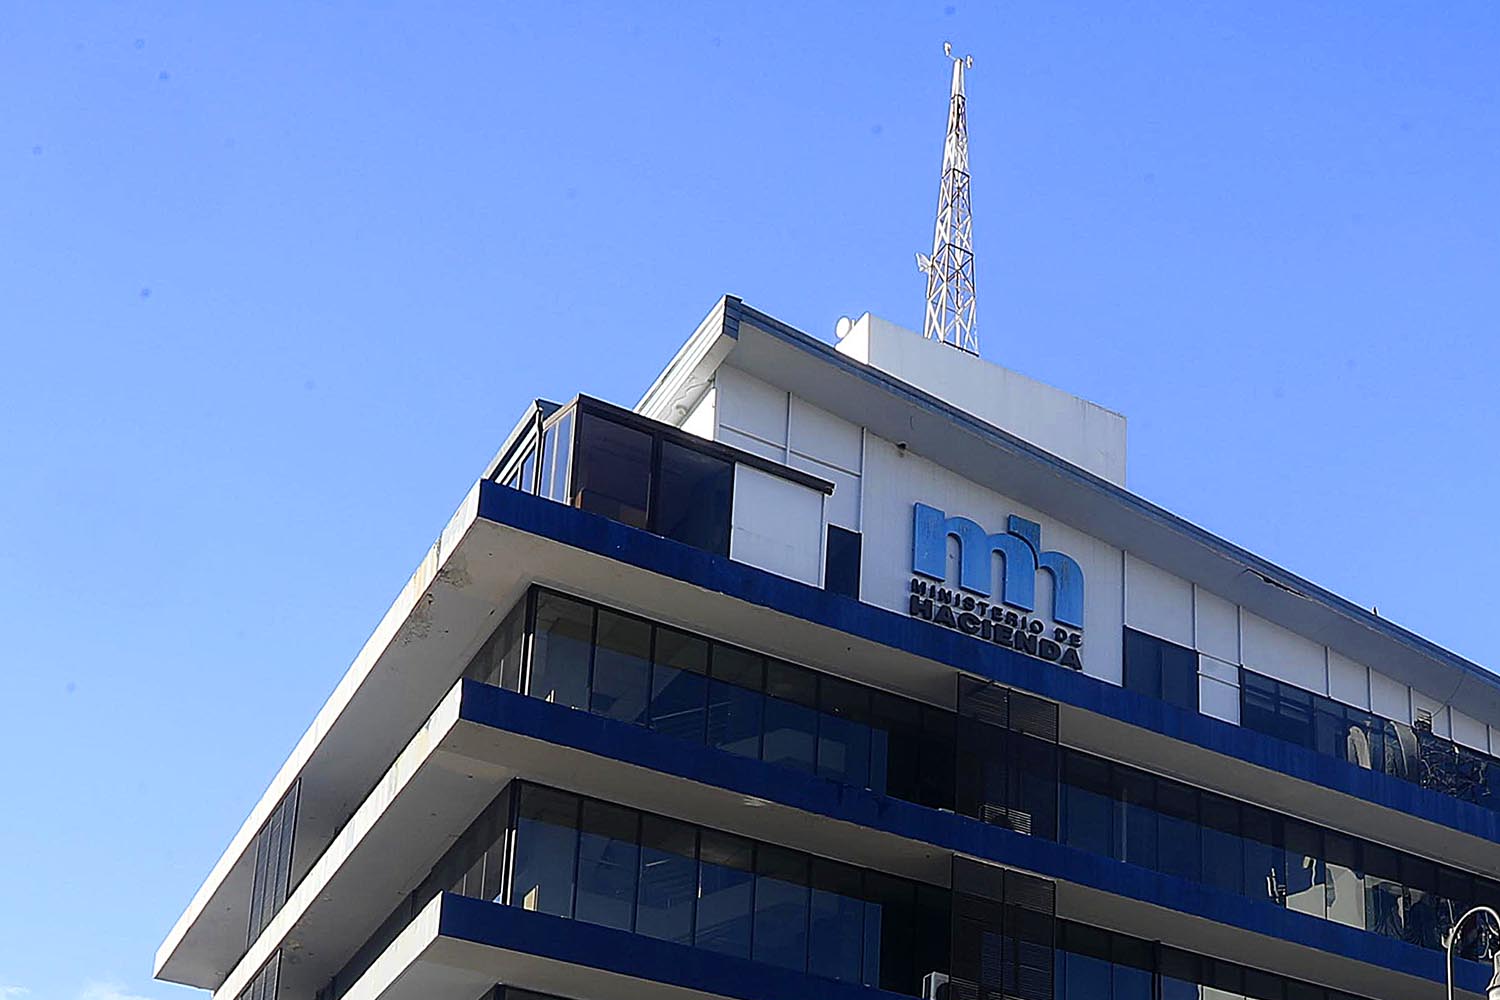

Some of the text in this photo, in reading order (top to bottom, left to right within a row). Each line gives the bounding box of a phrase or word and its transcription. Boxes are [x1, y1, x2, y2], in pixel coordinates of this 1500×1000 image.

[910, 594, 1083, 671] HACIENDA
[911, 578, 1083, 648] MINISTERIO DE
